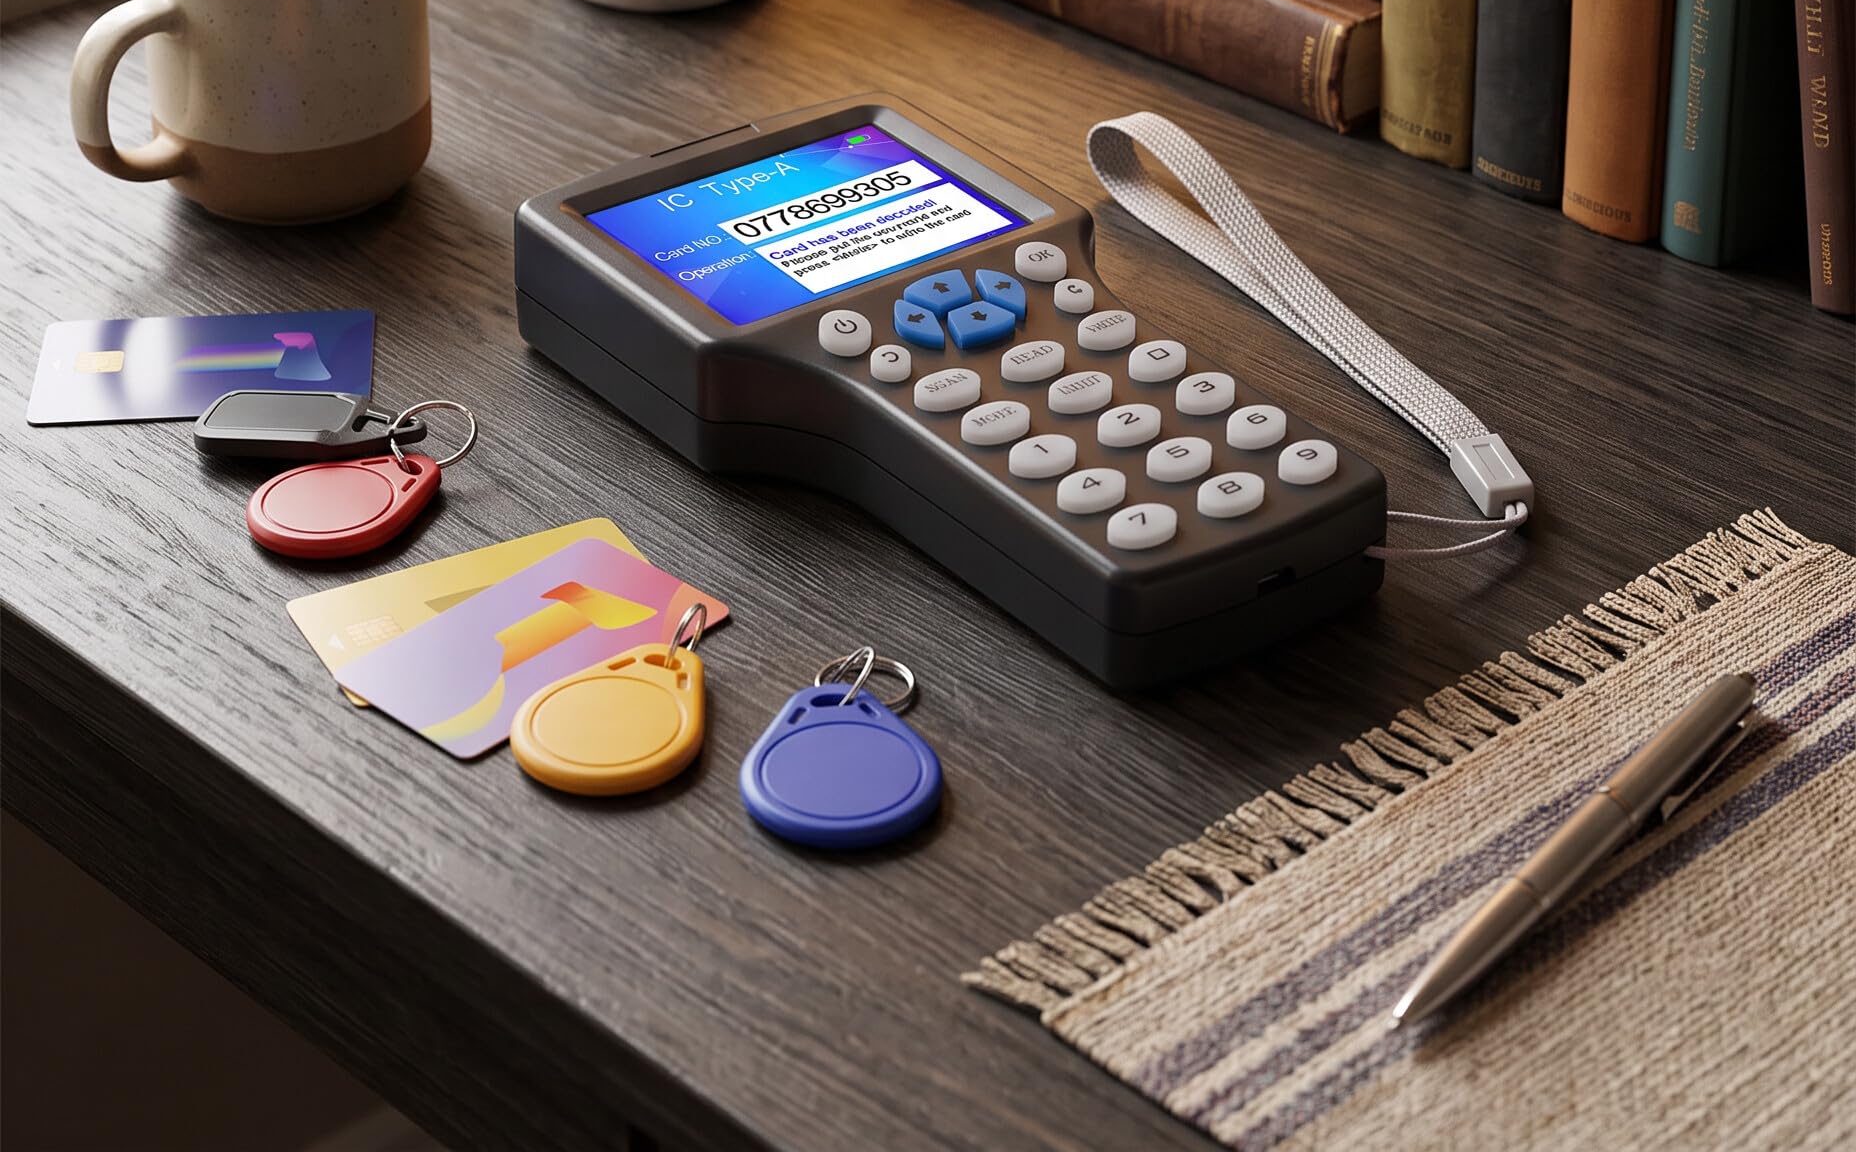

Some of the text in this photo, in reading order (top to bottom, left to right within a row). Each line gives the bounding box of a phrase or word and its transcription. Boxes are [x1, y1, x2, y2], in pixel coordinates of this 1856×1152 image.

[657, 160, 800, 213] IC Type-A
[654, 244, 696, 263] Card
[732, 170, 912, 238] 0778699305
[769, 243, 809, 260] Card
[806, 234, 839, 247] has
[1028, 249, 1054, 263] OK
[1193, 380, 1215, 393] 3
[1117, 411, 1140, 426] 2
[1246, 412, 1268, 425] 6
[1033, 443, 1049, 454] 1
[1166, 445, 1189, 458] 5
[1296, 448, 1318, 460] 9
[1082, 476, 1102, 489] 4
[1217, 481, 1242, 495] 8
[1128, 512, 1147, 525] 7
